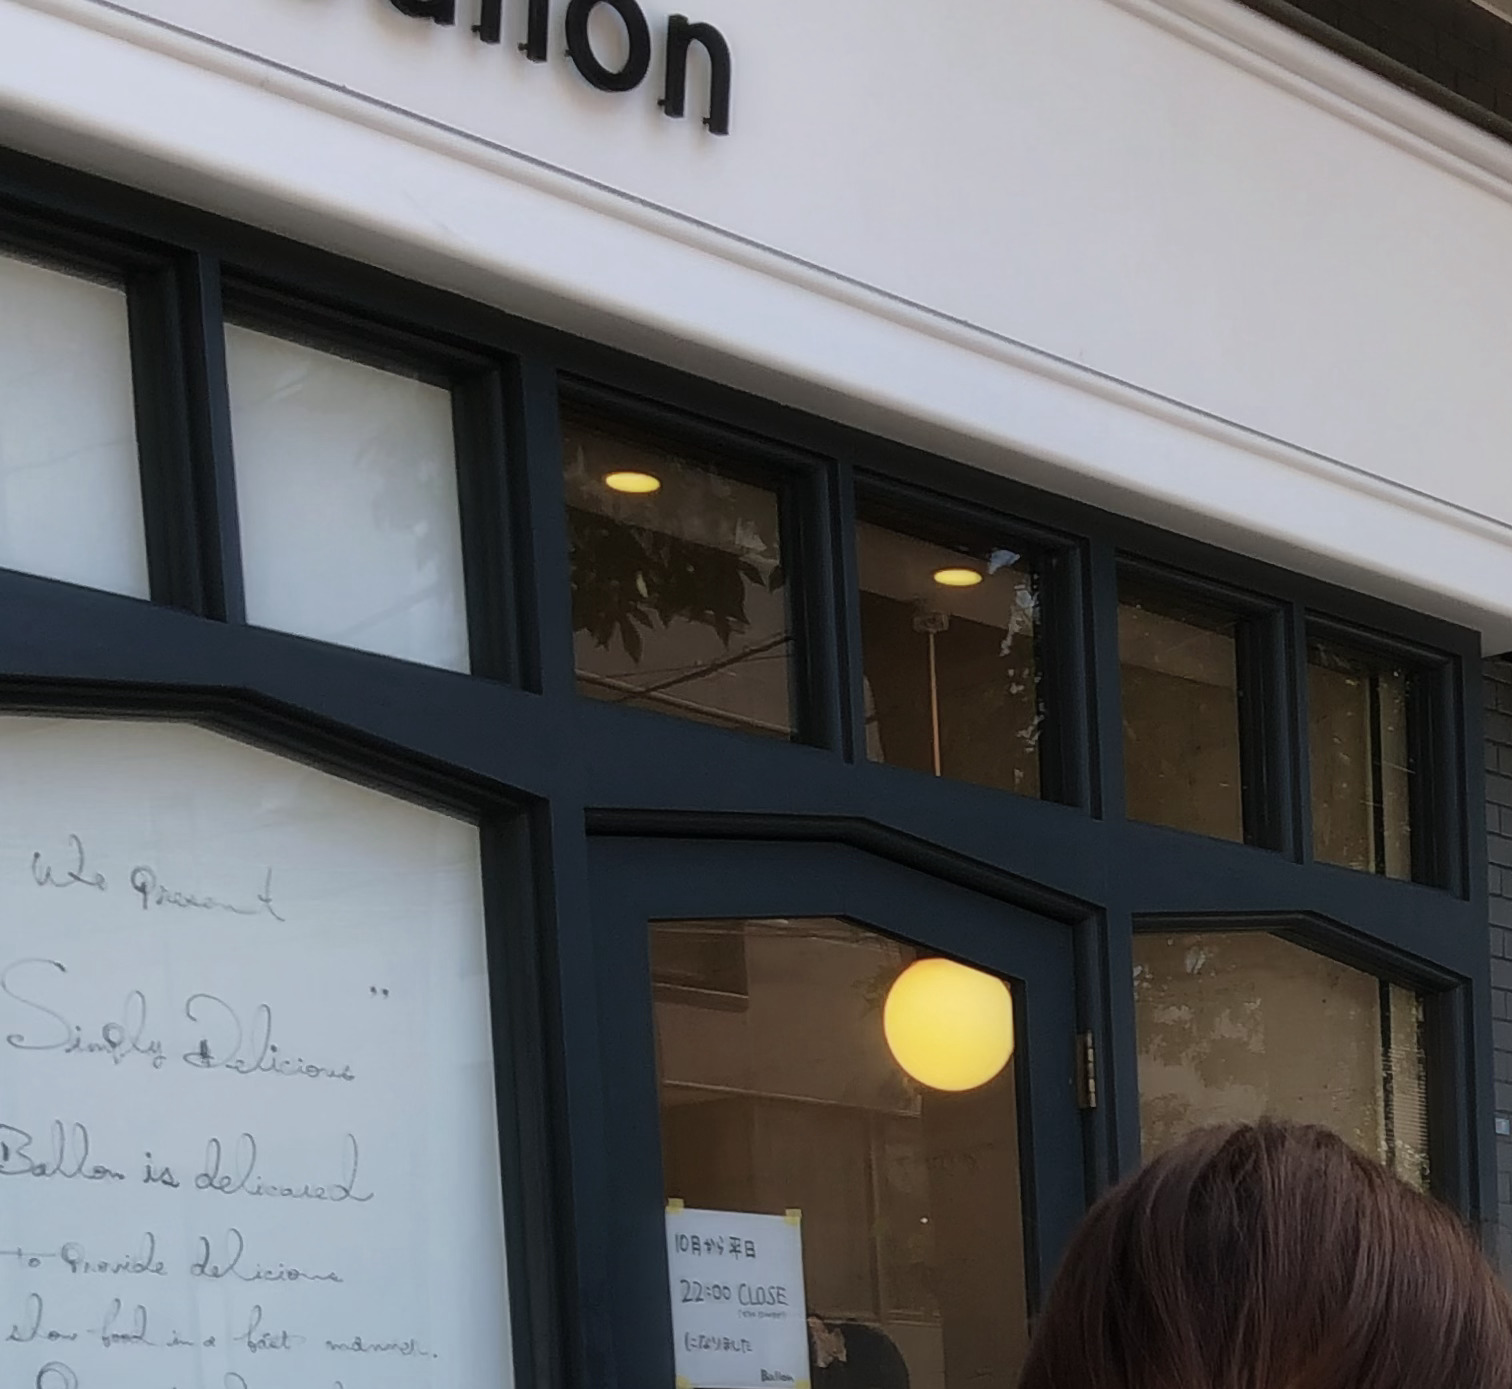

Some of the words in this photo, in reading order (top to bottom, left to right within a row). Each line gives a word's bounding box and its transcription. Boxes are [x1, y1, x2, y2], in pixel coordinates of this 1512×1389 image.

[0, 957, 167, 1069] Simply
[0, 1119, 125, 1180] Ballon
[142, 1151, 180, 1189] is
[680, 1279, 732, 1304] 22:00
[737, 1282, 790, 1306] CLOSE
[166, 1329, 194, 1348] in
[203, 1336, 216, 1348] a
[684, 1331, 753, 1354] になりました
